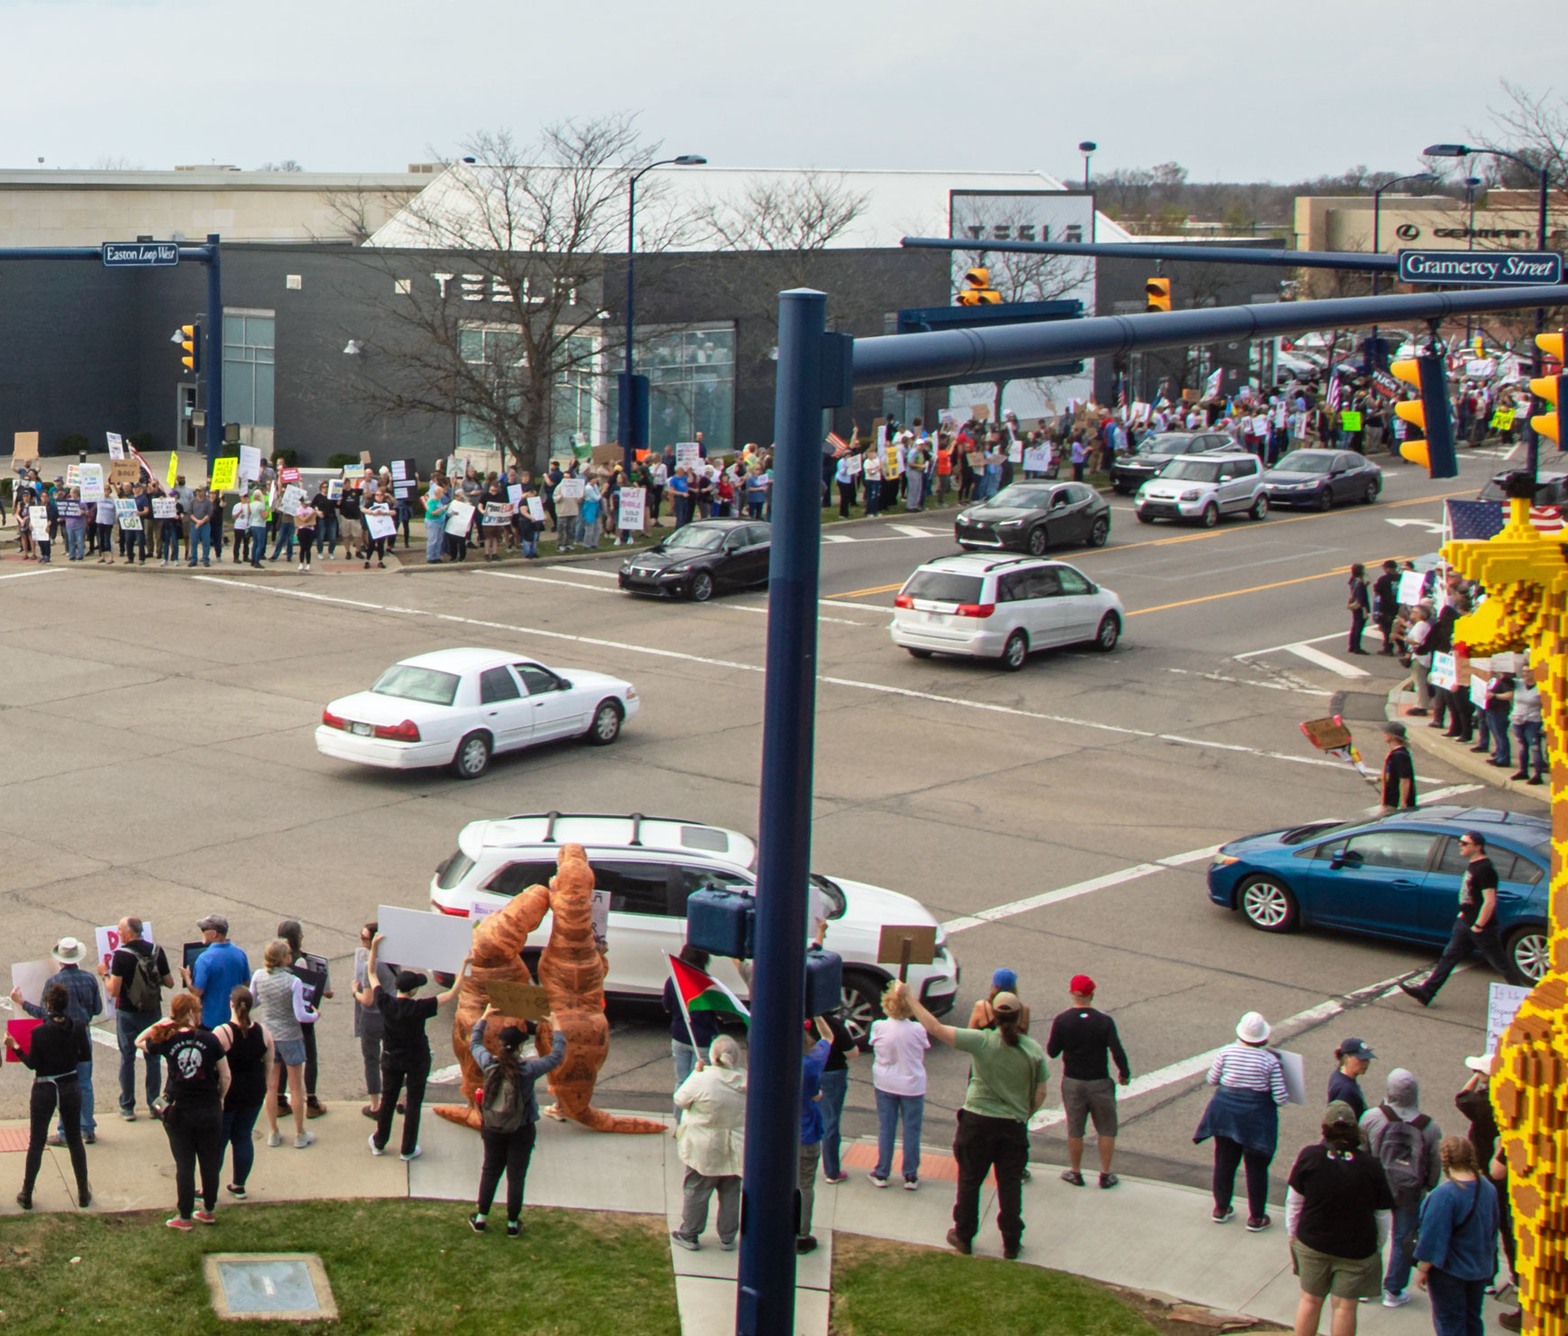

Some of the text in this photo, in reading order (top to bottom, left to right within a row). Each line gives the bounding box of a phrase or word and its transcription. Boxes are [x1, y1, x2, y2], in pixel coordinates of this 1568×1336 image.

[107, 246, 175, 263] Easton Loop West
[1406, 255, 1554, 279] Gramercy Street
[431, 273, 576, 305] TESLA
